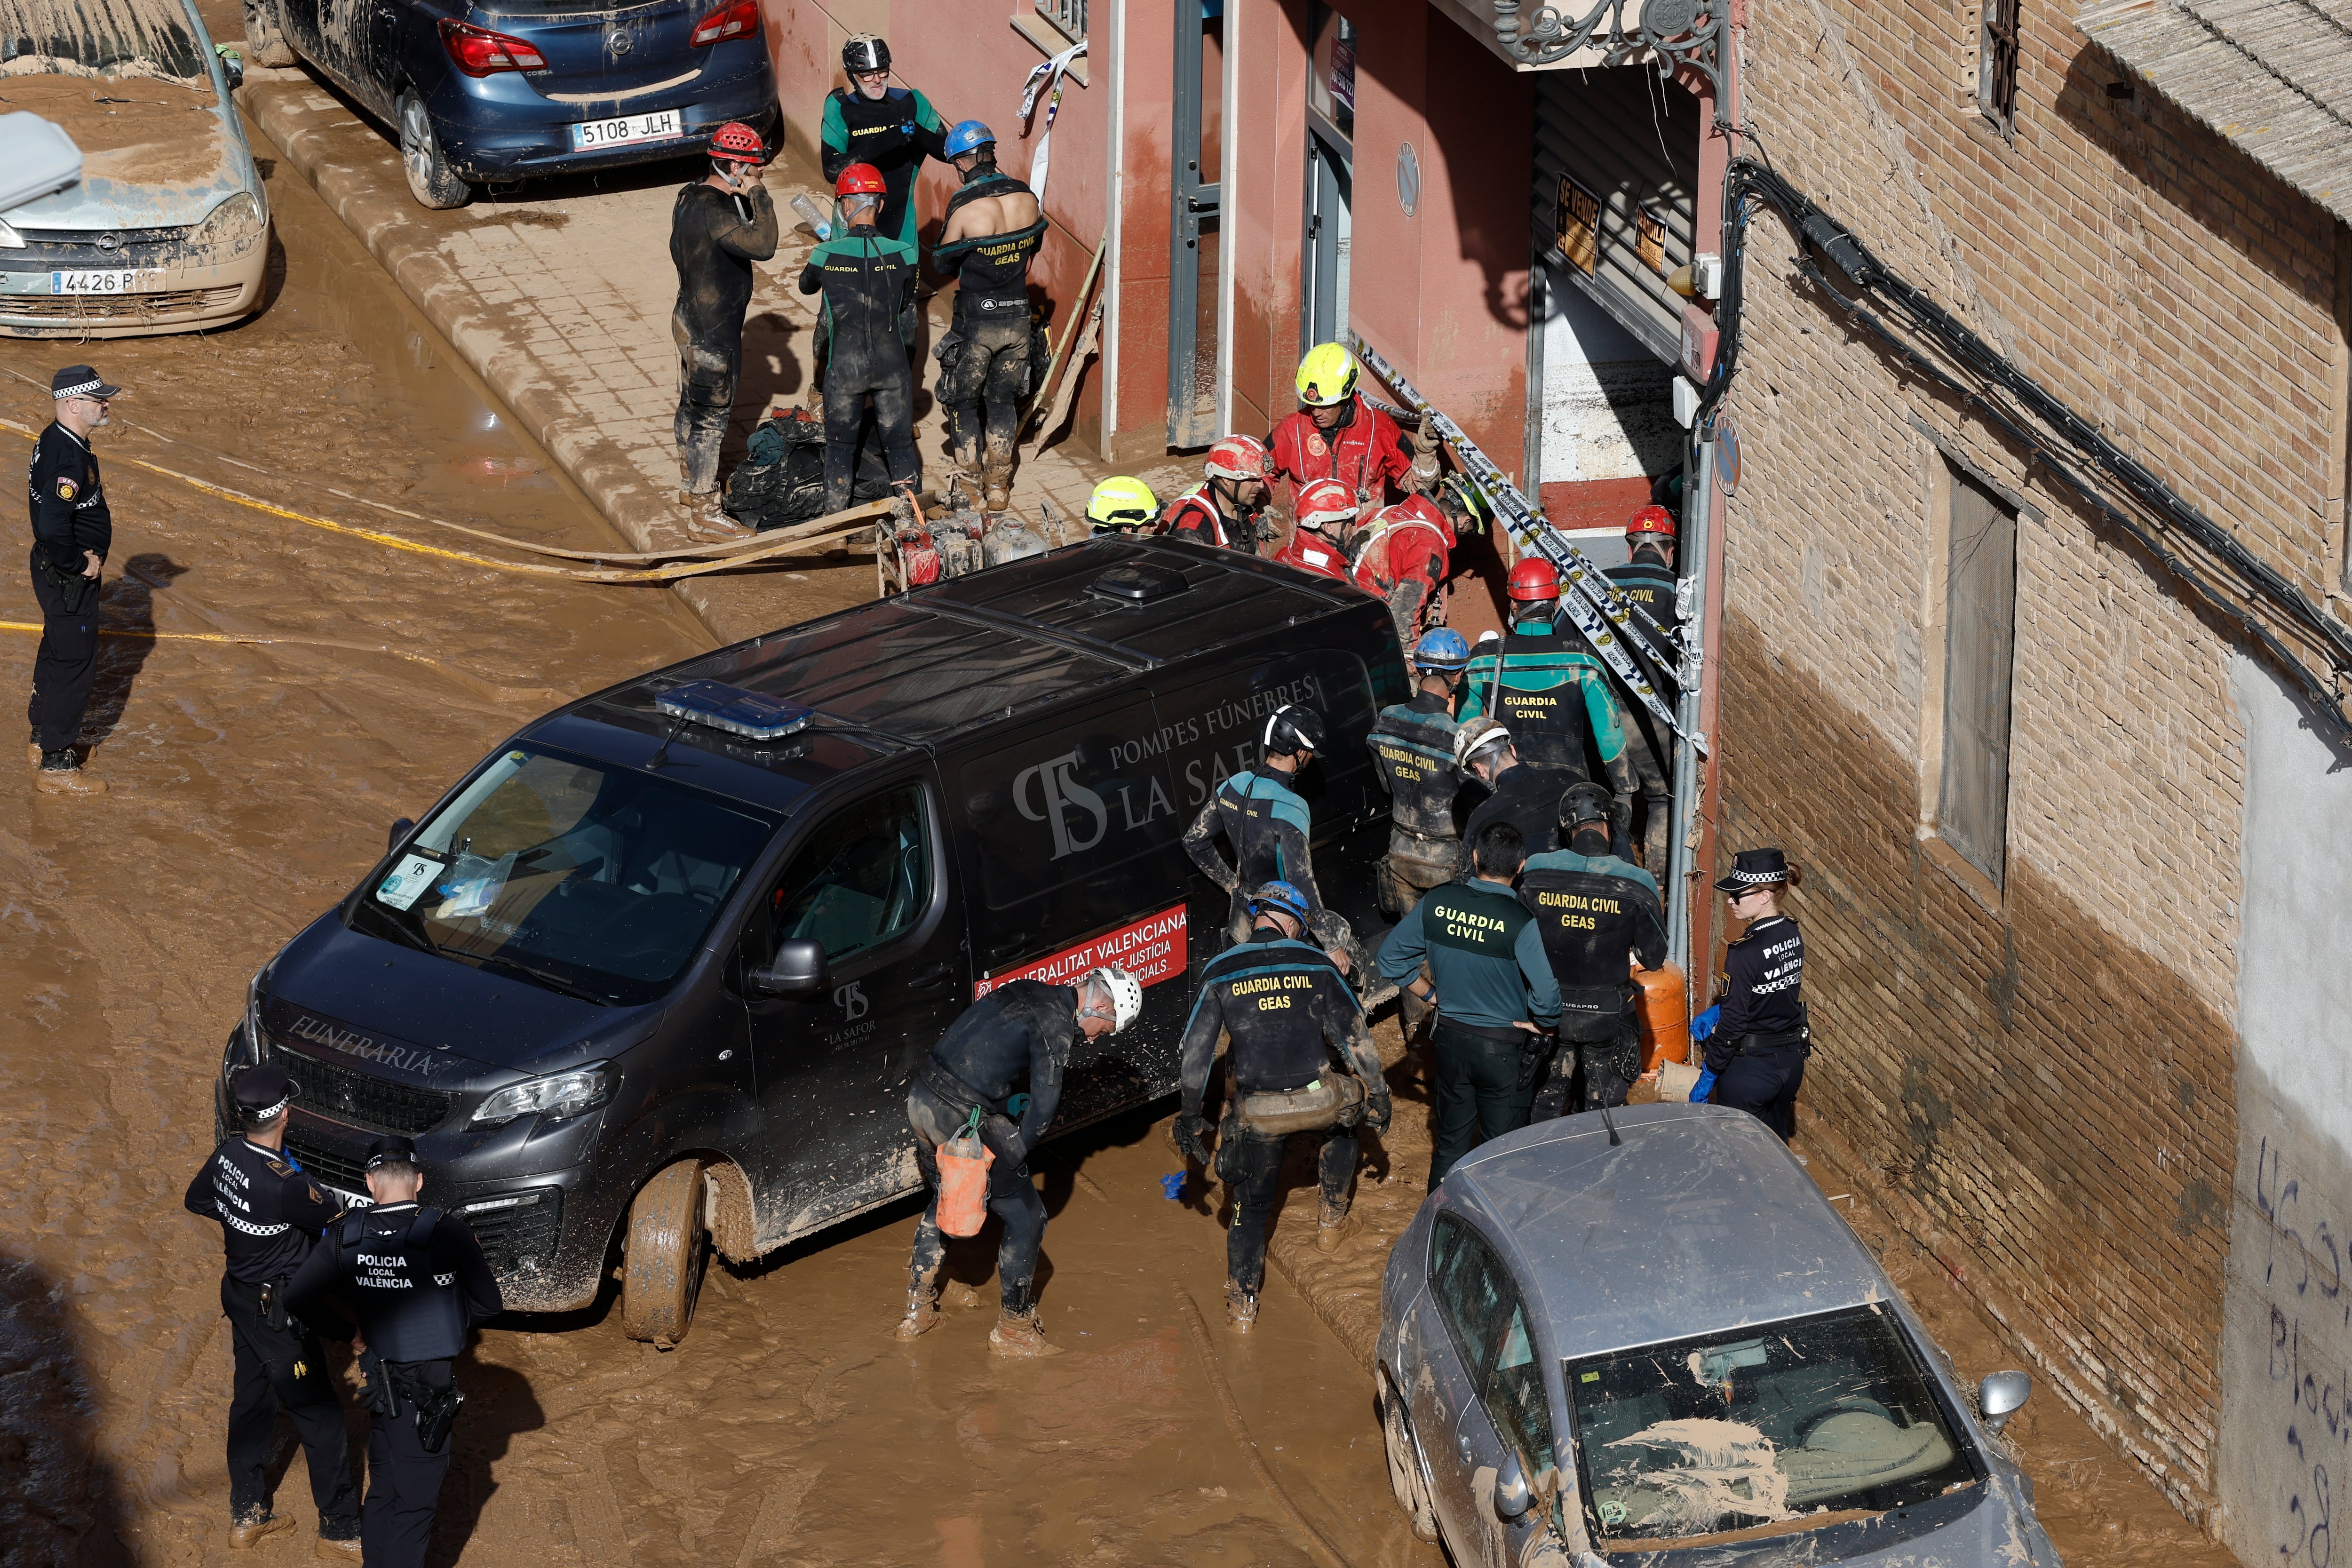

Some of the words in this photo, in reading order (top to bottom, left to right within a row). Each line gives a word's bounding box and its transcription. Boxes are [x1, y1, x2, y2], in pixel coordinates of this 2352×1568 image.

[1346, 80, 1354, 98] 727
[583, 121, 629, 143] 5108
[641, 113, 672, 135] JLH
[852, 127, 887, 137] GUARDIA
[1559, 178, 1571, 207] SE
[1571, 187, 1598, 230] VENDE
[977, 242, 1016, 256] GUARDIA
[1018, 235, 1035, 250] CIVIL
[994, 252, 1020, 266] GEAS
[66, 273, 115, 291] 4426
[63, 478, 77, 488] UPIC
[1494, 501, 1507, 519] VALENCIA
[1499, 493, 1512, 508] POLICIA
[1508, 503, 1521, 514] LOCAL
[1540, 535, 1553, 548] POLICIA
[1549, 544, 1563, 556] LOCAL
[1582, 577, 1596, 591] POLICIA
[1593, 587, 1605, 599] LOCAL
[1629, 589, 1654, 603] CIVIL
[1565, 600, 1582, 619] VALENCIA
[1570, 588, 1583, 606] POLICIA
[1581, 600, 1592, 616] LOCAL
[1605, 651, 1622, 667] VALENCIA
[1504, 697, 1557, 706] GUARDIA
[1108, 717, 1200, 770] POMPES
[1204, 675, 1315, 735] FÚNEBRES
[1516, 710, 1547, 719] CIVIL
[1379, 745, 1413, 765] GUARDIA
[1414, 756, 1438, 772] CIVIL
[1395, 765, 1421, 782] GEAS
[1118, 775, 1177, 832] LA
[1219, 797, 1238, 811] GUARDIA
[1246, 809, 1258, 818] CIVIL
[1398, 849, 1436, 863] SCUBAPRO
[1538, 891, 1589, 911] GUARDIA
[1591, 897, 1621, 915] CIVIL
[1434, 905, 1505, 933] GUARDIA
[1560, 914, 1596, 931] GEAS
[1446, 923, 1486, 944] CIVIL
[998, 948, 1093, 989] NERALITAT
[1096, 911, 1187, 960] VALENCIANA
[1762, 936, 1802, 960] POLICIA
[1778, 950, 1796, 962] LOCAL
[1063, 966, 1110, 986] GENE
[1112, 957, 1125, 971] DE
[1127, 939, 1171, 969] JUSTÍCIA
[1131, 958, 1168, 983] ICIALS
[1764, 956, 1804, 980] VAÈNCI
[1232, 977, 1281, 996] GUARDIA
[1283, 975, 1312, 990] CIVIL
[1258, 995, 1291, 1011] GEAS
[1561, 1001, 1599, 1010] CUBAPRO
[830, 1032, 842, 1044] LA
[844, 1020, 877, 1039] SAFOR
[286, 1014, 432, 1075] FUNERARIA
[1268, 1105, 1318, 1114] SCUBAPRO
[218, 1154, 250, 1189] POLICIA
[221, 1171, 238, 1190] LOCAL
[213, 1175, 251, 1213] VALÈNCIA
[357, 1254, 407, 1267] POLICIA
[355, 1276, 413, 1289] VALÈNCIA
[368, 1268, 396, 1276] LOCAL
